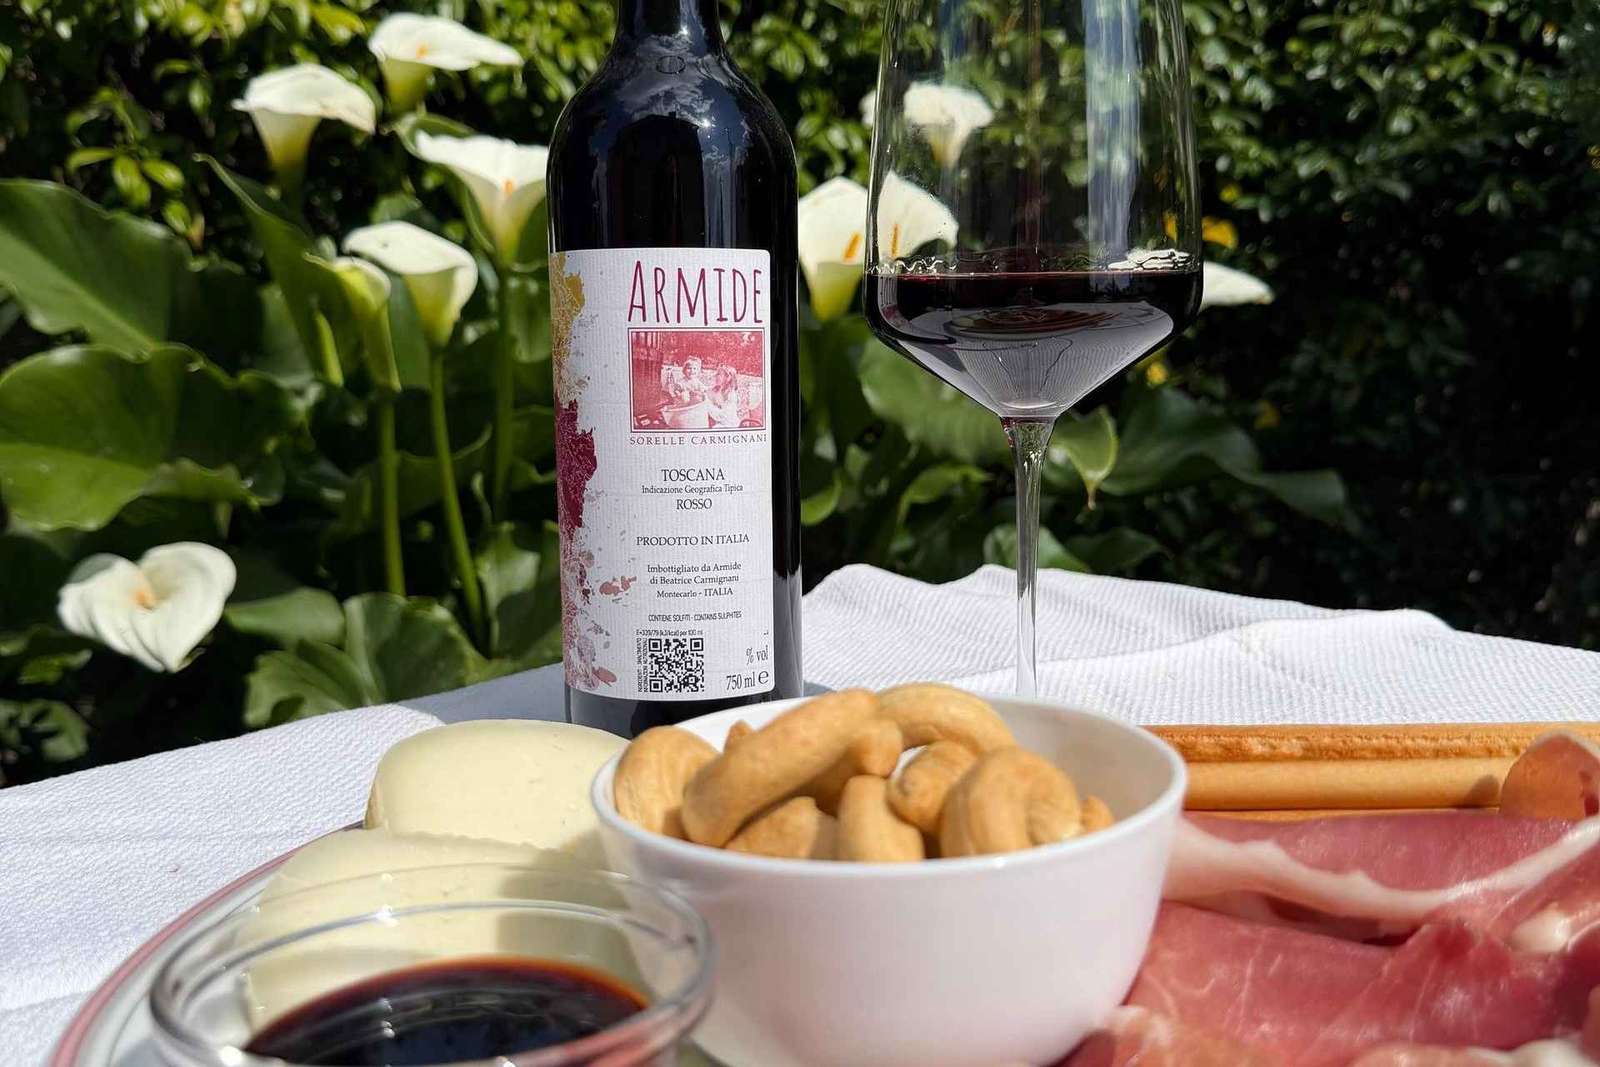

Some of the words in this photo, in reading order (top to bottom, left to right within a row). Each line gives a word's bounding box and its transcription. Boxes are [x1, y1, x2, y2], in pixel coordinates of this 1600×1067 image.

[627, 260, 763, 326] ARMIDE
[629, 436, 685, 445] SORELLE
[691, 434, 767, 445] CARMIGNANI
[661, 468, 725, 481] TOSCANA
[641, 485, 683, 494] Indicazione
[685, 484, 722, 495] Geografica
[724, 483, 744, 494] Tipica
[676, 498, 713, 510] ROSSO
[636, 536, 699, 546] PRODOTTO
[701, 535, 713, 545] IN
[716, 533, 750, 545] ITALIA
[647, 564, 699, 575] Imbottigliato
[701, 563, 711, 572] da
[713, 561, 742, 572] Armide
[649, 576, 658, 585] di
[660, 576, 692, 585] Beatrice
[694, 575, 739, 586] Carmignani
[656, 589, 697, 598] Montecarlo
[704, 587, 734, 597] ITALIA
[756, 645, 769, 661] vol
[726, 673, 743, 690] 750
[744, 671, 756, 688] ml
